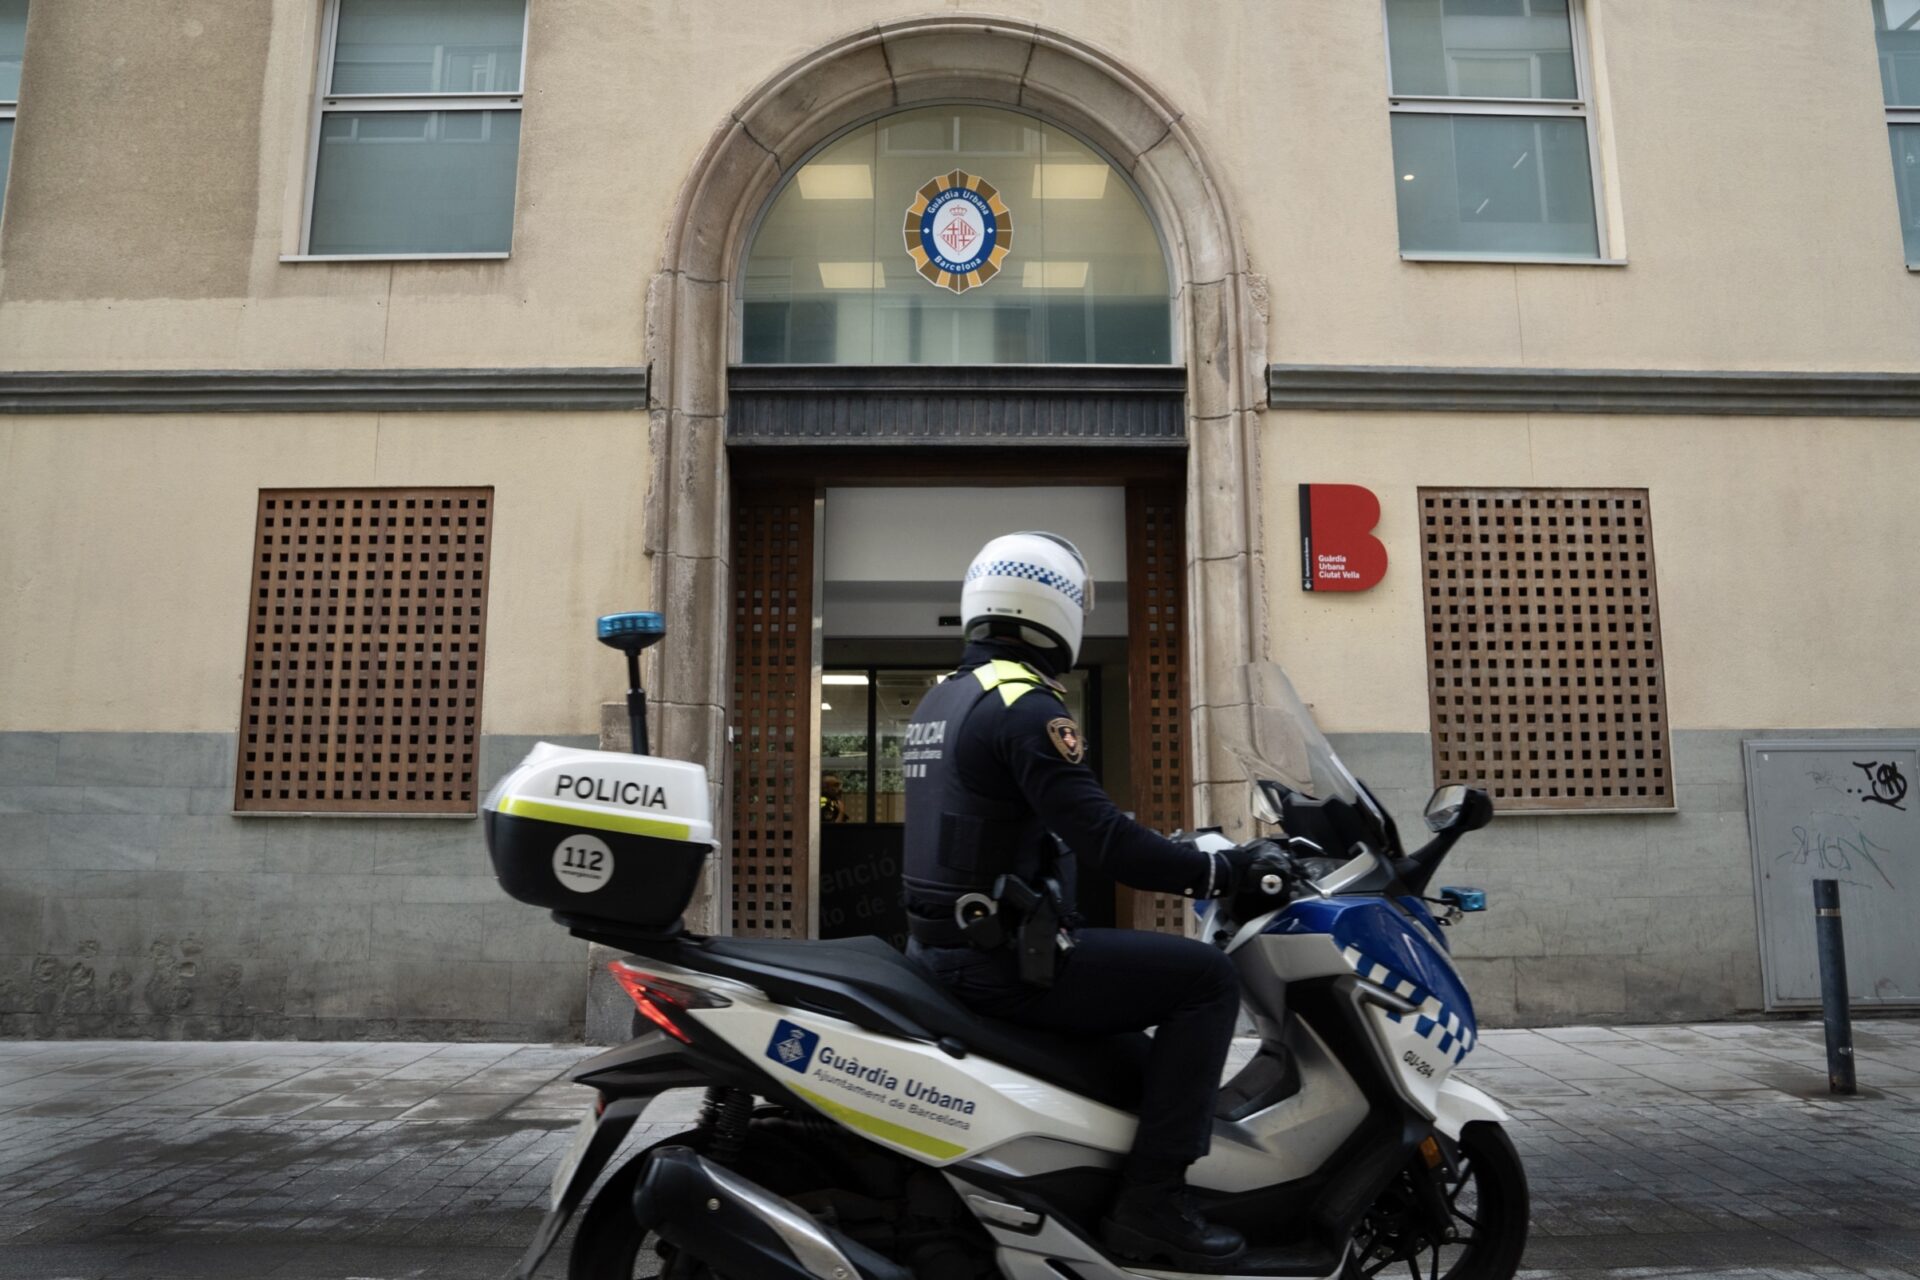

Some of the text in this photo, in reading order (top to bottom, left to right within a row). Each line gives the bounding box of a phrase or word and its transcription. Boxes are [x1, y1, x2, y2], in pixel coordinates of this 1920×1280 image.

[927, 190, 990, 216] Guàrdia Urbana
[934, 255, 982, 271] Barcelona
[1319, 571, 1360, 579] Ciutat Vella
[554, 774, 668, 810] POLICIA
[563, 846, 604, 871] 112
[818, 1046, 977, 1115] Guàrdia Urbana
[813, 1068, 971, 1131] Ajuntament de Barcelona
